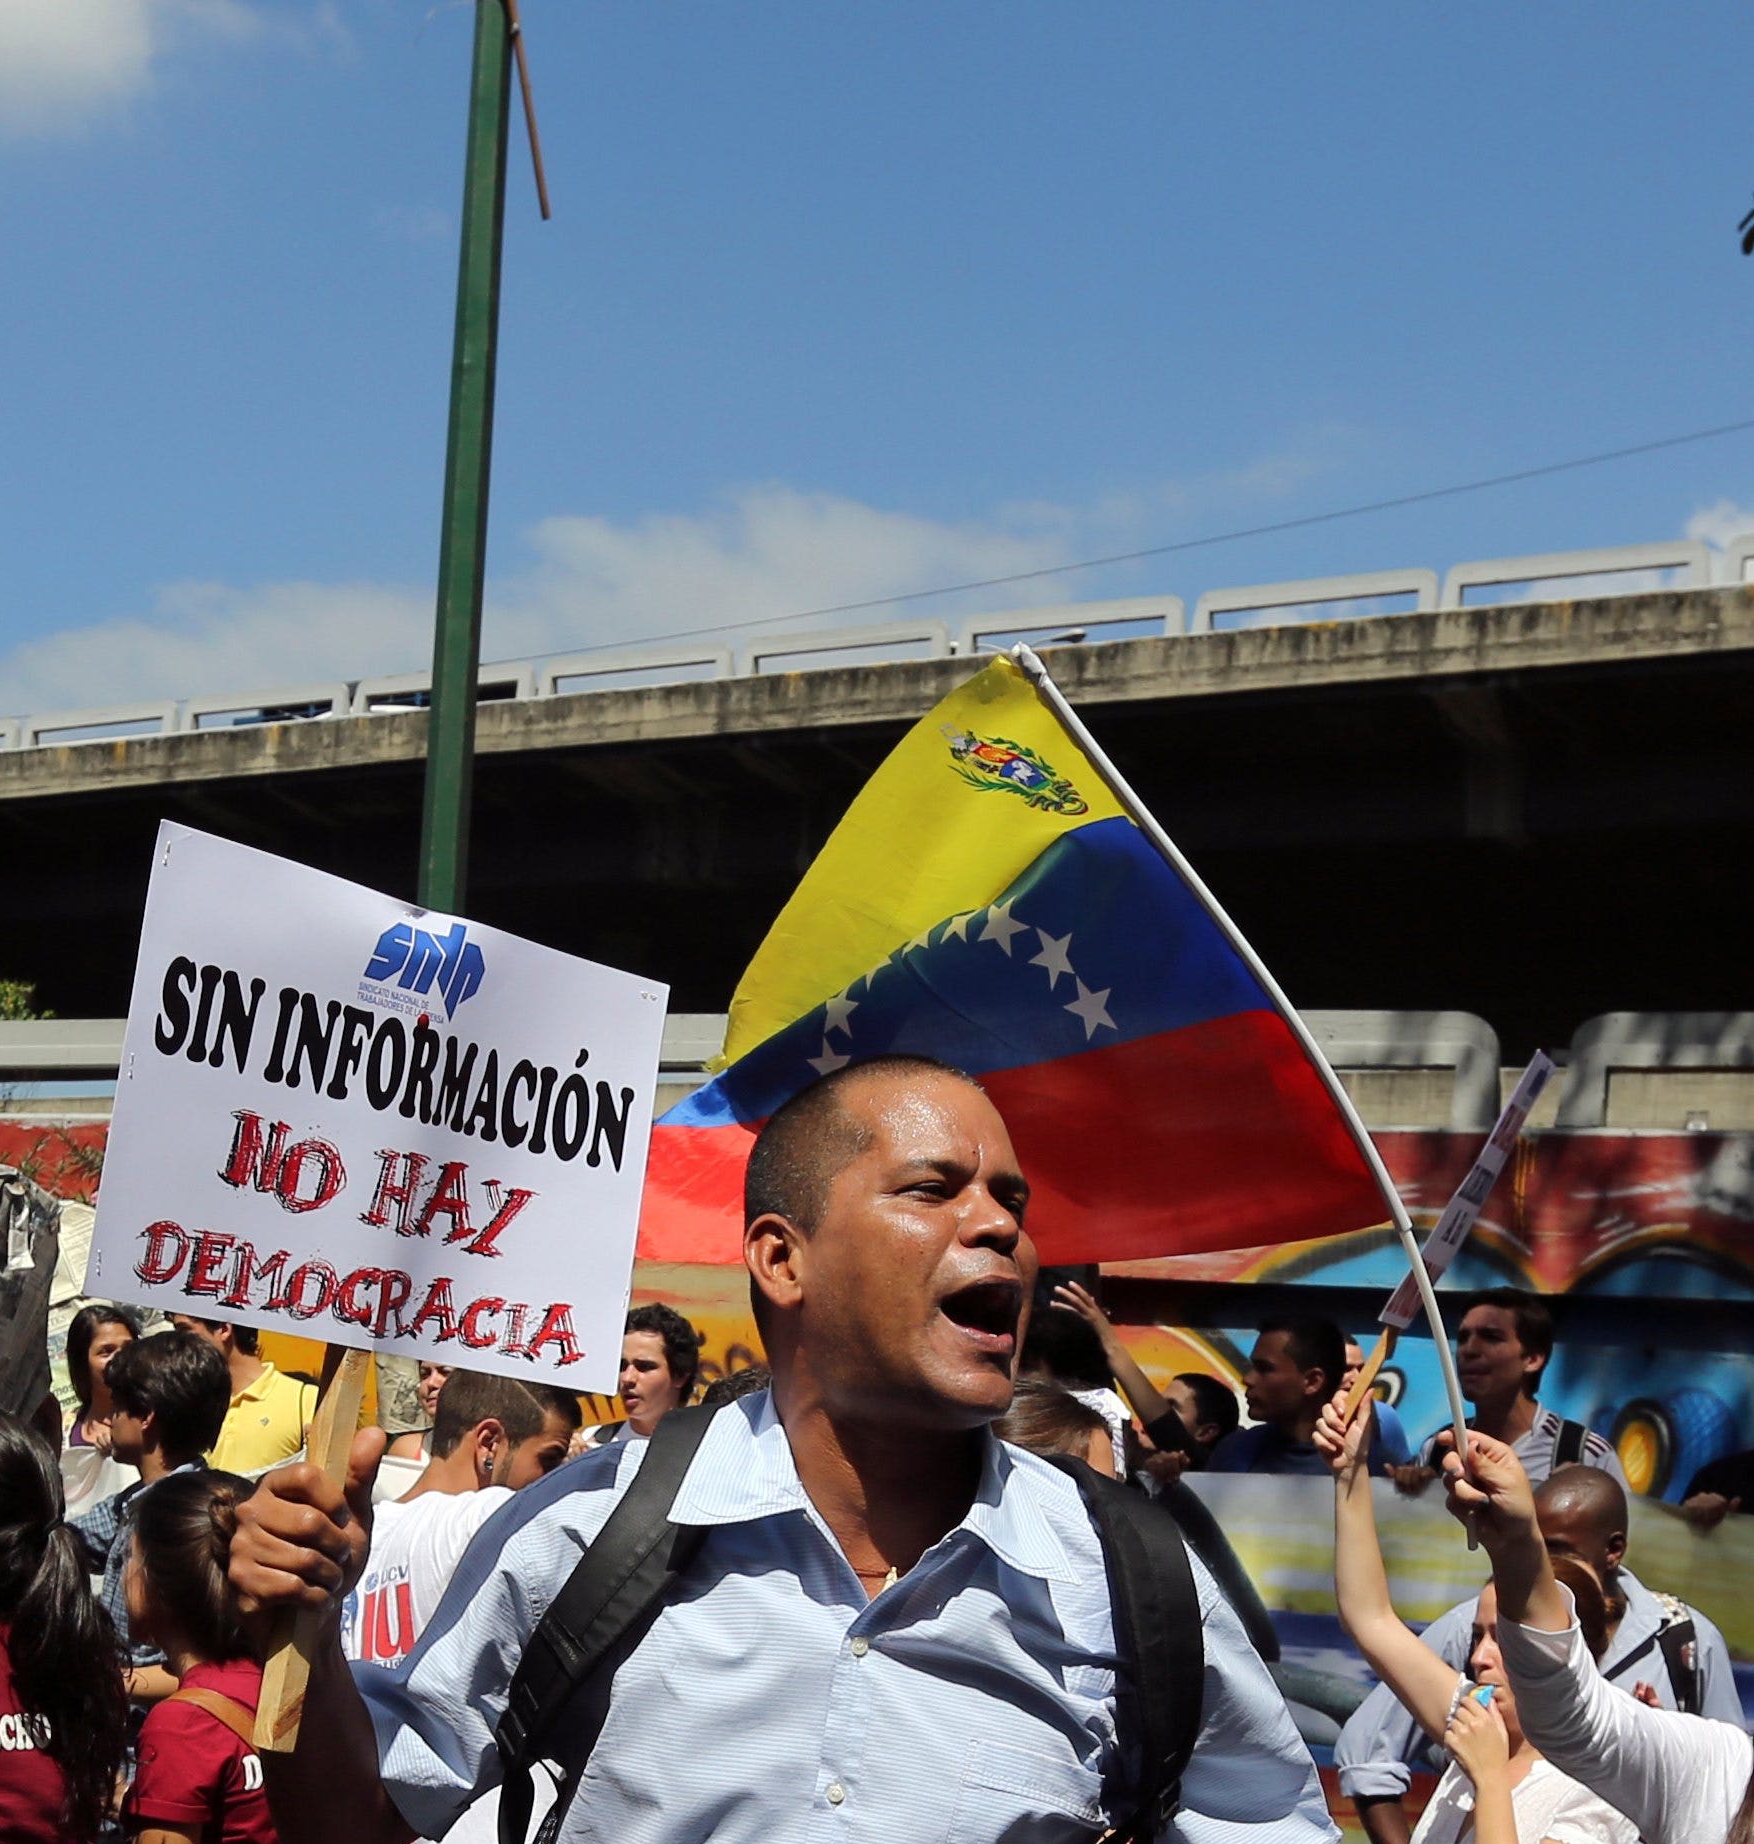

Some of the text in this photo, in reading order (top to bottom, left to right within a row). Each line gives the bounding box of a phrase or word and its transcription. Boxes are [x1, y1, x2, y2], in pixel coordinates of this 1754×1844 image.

[154, 956, 635, 1173] SIN INFORMACIÓN
[218, 1108, 539, 1258] NO HAY
[134, 1220, 587, 1367] DEMOCRACIA
